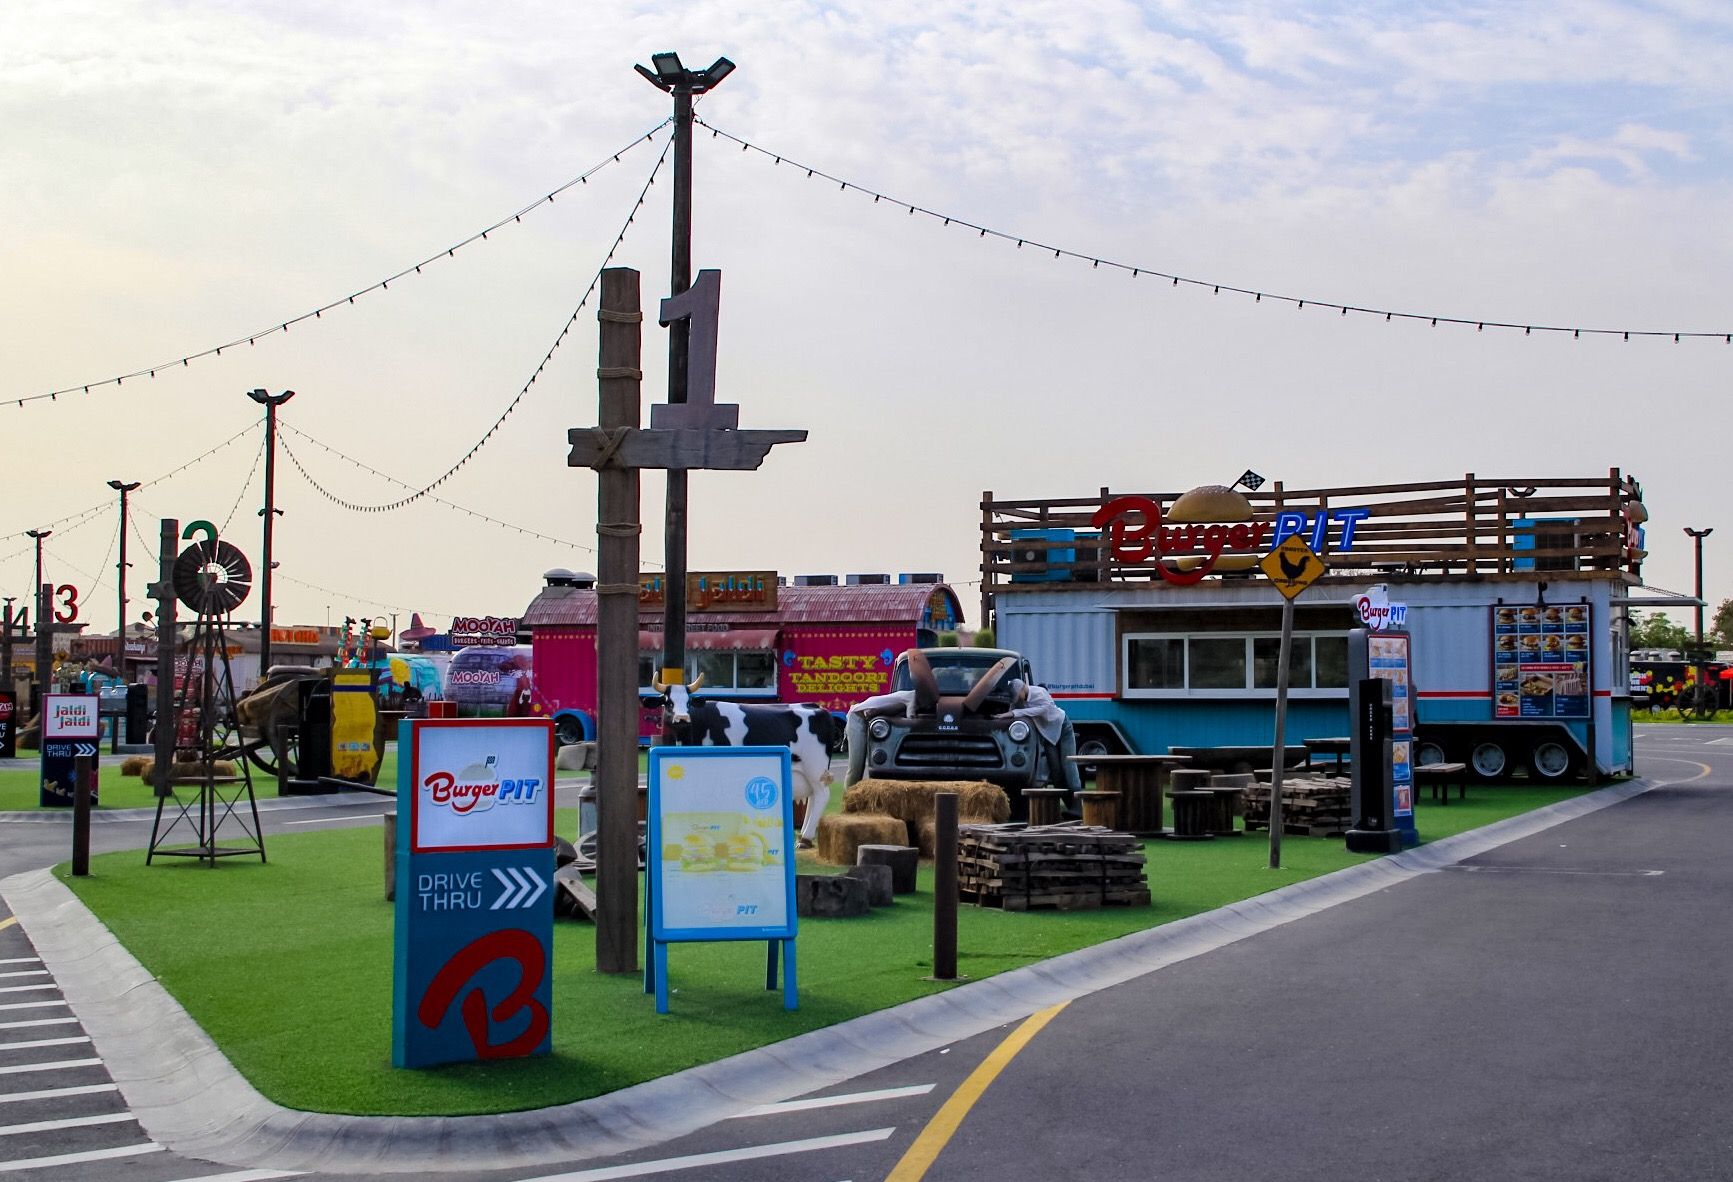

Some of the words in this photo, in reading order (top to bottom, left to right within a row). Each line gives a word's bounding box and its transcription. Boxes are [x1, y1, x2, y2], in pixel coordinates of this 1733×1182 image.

[651, 269, 739, 430] 1
[1090, 495, 1271, 586] Burger
[1270, 507, 1370, 553] PIT
[54, 584, 78, 624] 3
[1358, 597, 1390, 631] Burger
[1390, 606, 1406, 620] PIT
[797, 655, 878, 670] TASTY
[788, 671, 889, 684] TANDOORI
[796, 683, 880, 693] DELIGHTS
[424, 771, 499, 813] Burger
[498, 778, 541, 801] PIT
[418, 872, 483, 892] DRIVE
[418, 891, 483, 911] THRU
[736, 904, 758, 915] PIT
